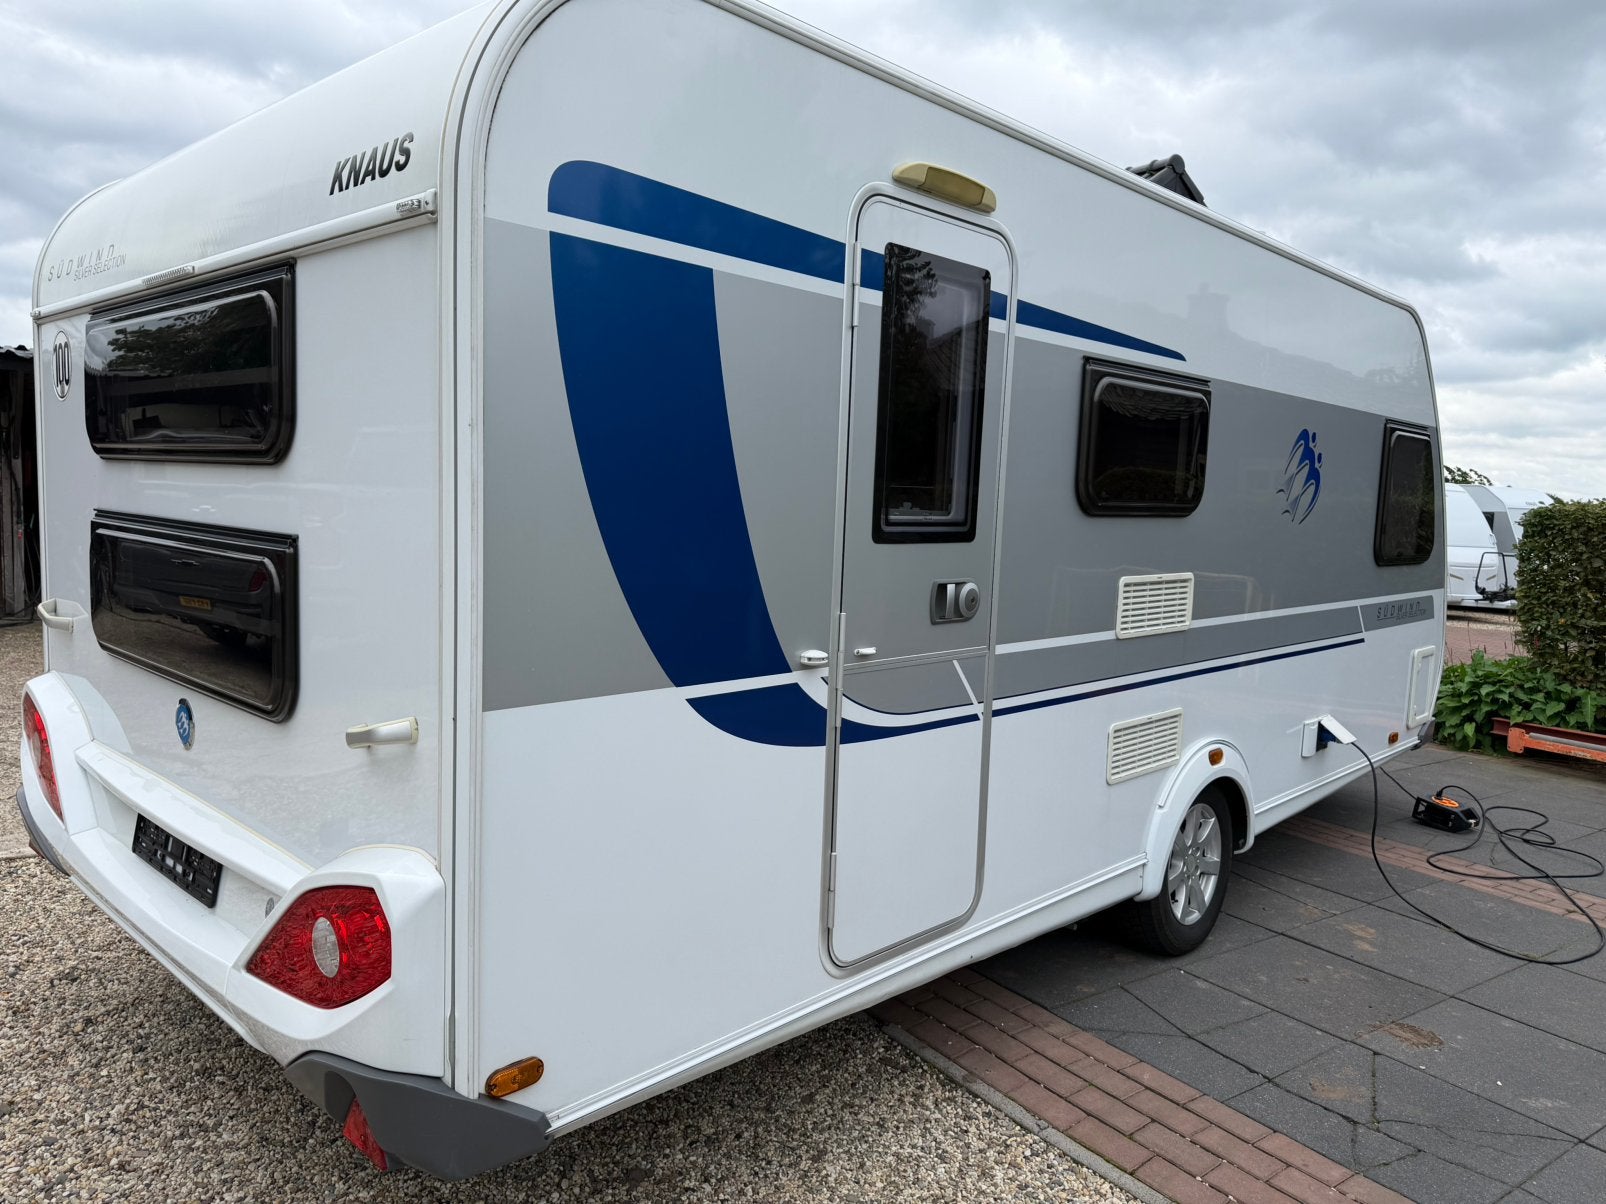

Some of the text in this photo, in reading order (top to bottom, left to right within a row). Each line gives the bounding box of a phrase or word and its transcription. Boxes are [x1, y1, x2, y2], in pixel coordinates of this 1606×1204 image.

[328, 131, 415, 197] KNAUS
[92, 252, 127, 277] SELECTION
[53, 340, 70, 388] 100
